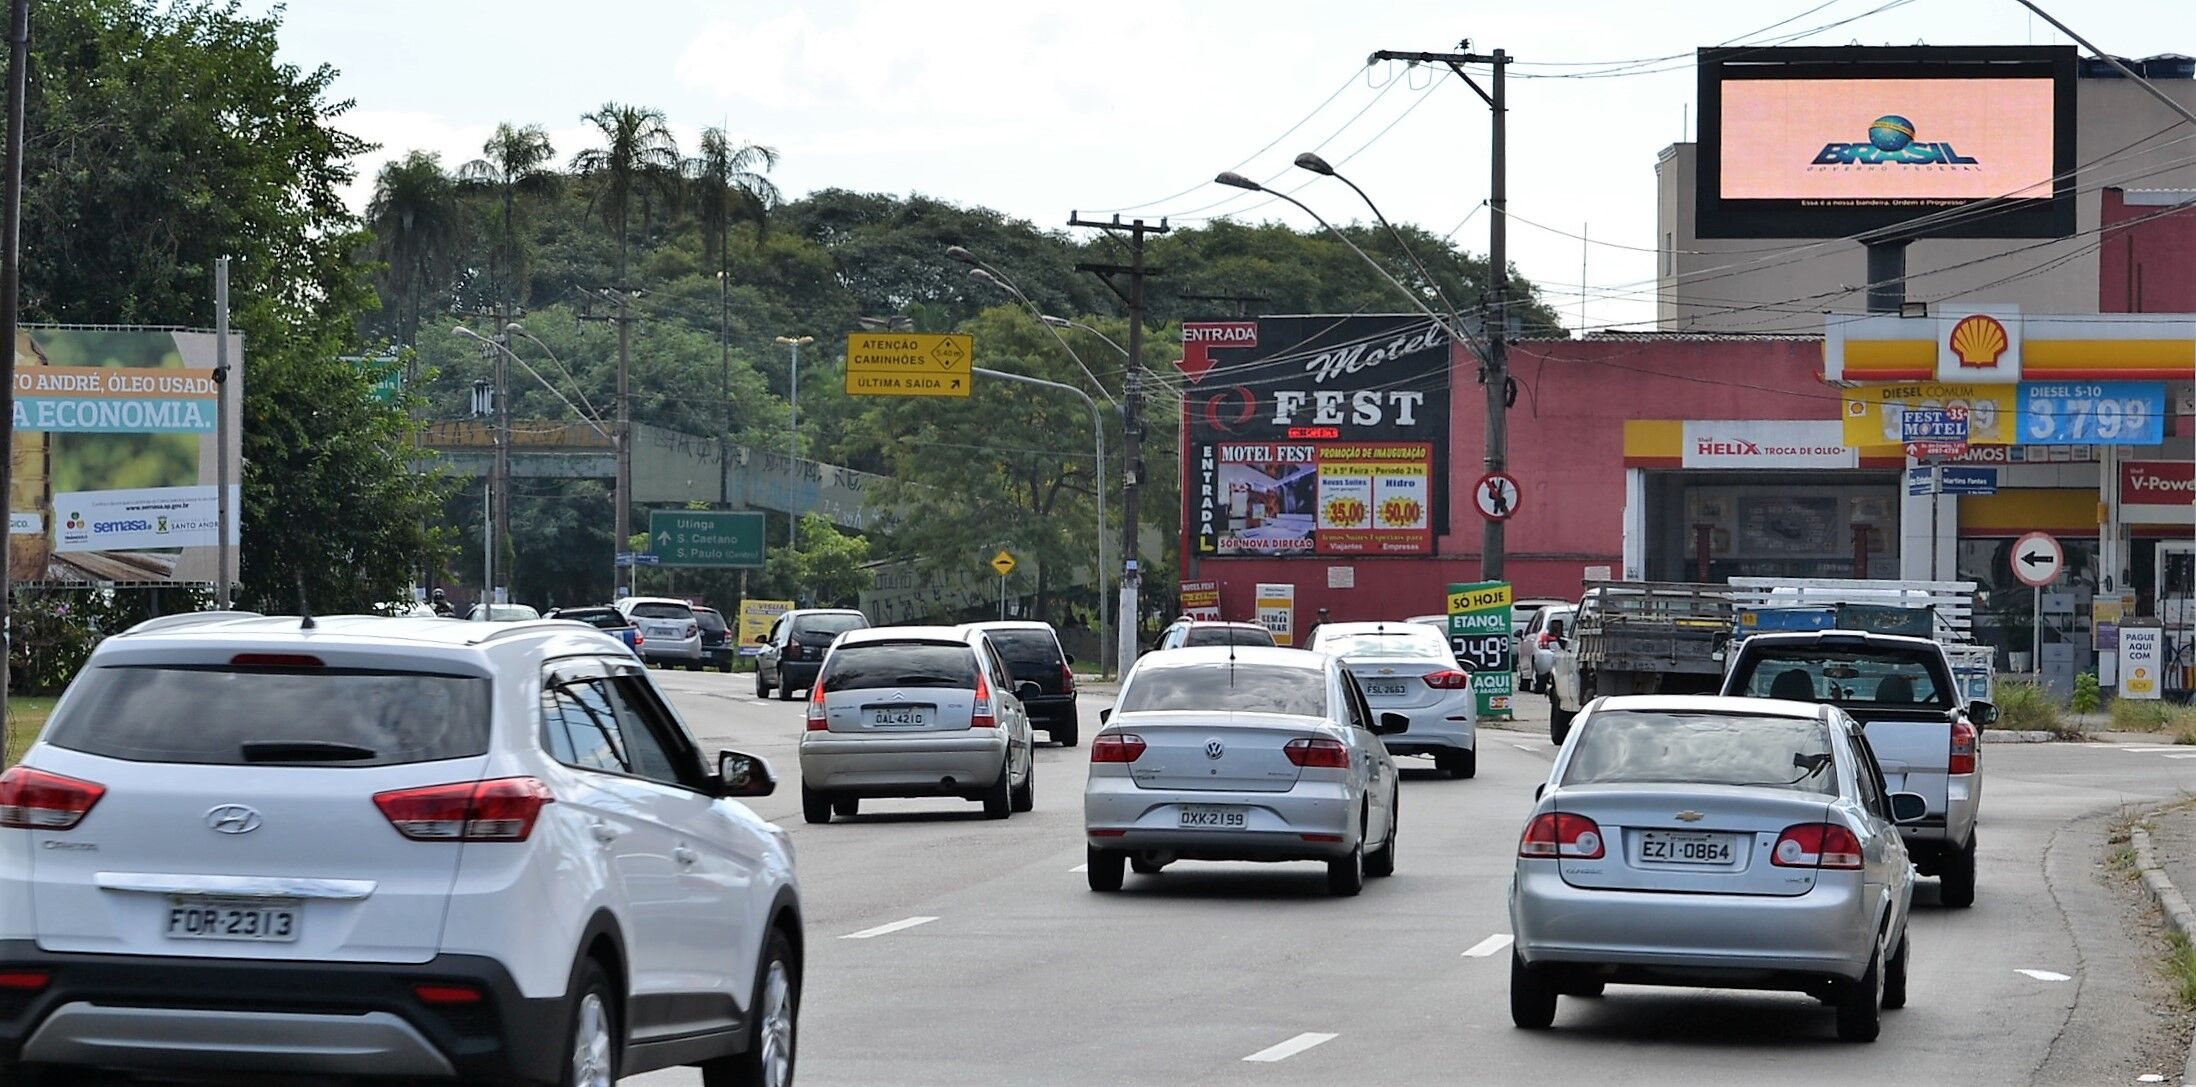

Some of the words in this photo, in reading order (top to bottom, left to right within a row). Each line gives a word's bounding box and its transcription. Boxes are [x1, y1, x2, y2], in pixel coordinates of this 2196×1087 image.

[1811, 142, 1979, 165] BRASIL
[1184, 328, 1256, 341] ENTRADA
[863, 339, 918, 351] ATENÇÃO
[1305, 322, 1443, 383] Motel
[854, 355, 925, 365] CAMINHÕES
[36, 372, 104, 393] ANDRÉ,
[108, 372, 155, 392] ÓLEO
[858, 376, 901, 388] ÚLTIMA
[905, 376, 941, 388] SAÍDA
[1882, 386, 1922, 399] DIESEL
[1926, 385, 1974, 398] COMUM
[2030, 386, 2071, 397] DIESEL
[13, 401, 31, 427] A
[37, 401, 212, 428] ECONOMIA.
[1272, 391, 1424, 426] FEST
[1904, 412, 1943, 422] FEST
[1221, 446, 1273, 462] MOTEL
[1277, 446, 1315, 461] FEST
[1319, 446, 1361, 459] PROMOÇÃO
[1362, 448, 1372, 458] DE
[1374, 446, 1426, 460] INAUGURAÇÃO
[1698, 443, 1759, 455] HELIX
[1764, 447, 1796, 455] TROCA
[1800, 447, 1812, 455] DE
[1349, 467, 1368, 475] Feira
[1201, 446, 1213, 534] ENTRADA
[1330, 503, 1365, 526] 35,00
[1385, 503, 1421, 526] 50,00
[94, 519, 147, 533] semasa
[171, 522, 196, 530] SANTO
[199, 521, 218, 529] ANDR
[677, 519, 714, 531] Utinga
[691, 533, 738, 544] Caetano
[1220, 539, 1240, 548] SOB
[1242, 539, 1269, 548] NOVA
[1406, 535, 1423, 543] para
[1329, 543, 1362, 551] Viajantes
[1382, 543, 1419, 551] Empresas
[691, 549, 723, 558] Paulo
[1453, 594, 1470, 609] SÓ
[1473, 592, 1504, 607] HOJE
[1453, 615, 1506, 628] ETANOL
[2129, 652, 2151, 660] COM
[1474, 676, 1510, 688] AQUI
